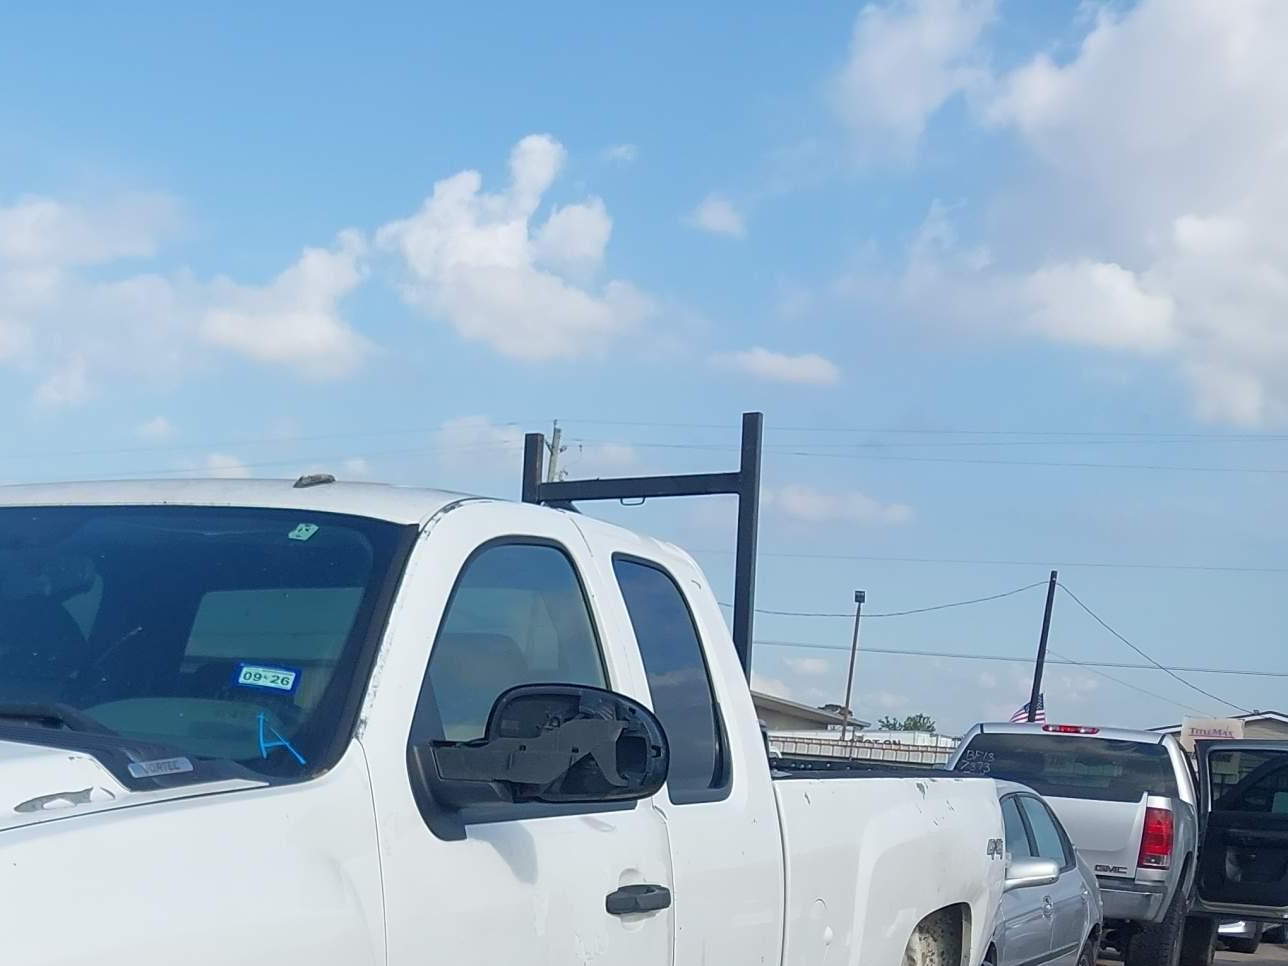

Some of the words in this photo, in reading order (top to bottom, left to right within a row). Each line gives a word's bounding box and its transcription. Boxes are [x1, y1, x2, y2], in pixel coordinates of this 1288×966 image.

[243, 671, 263, 682] 09
[270, 674, 291, 686] 26
[258, 712, 307, 766] A
[1095, 864, 1128, 874] GMC
